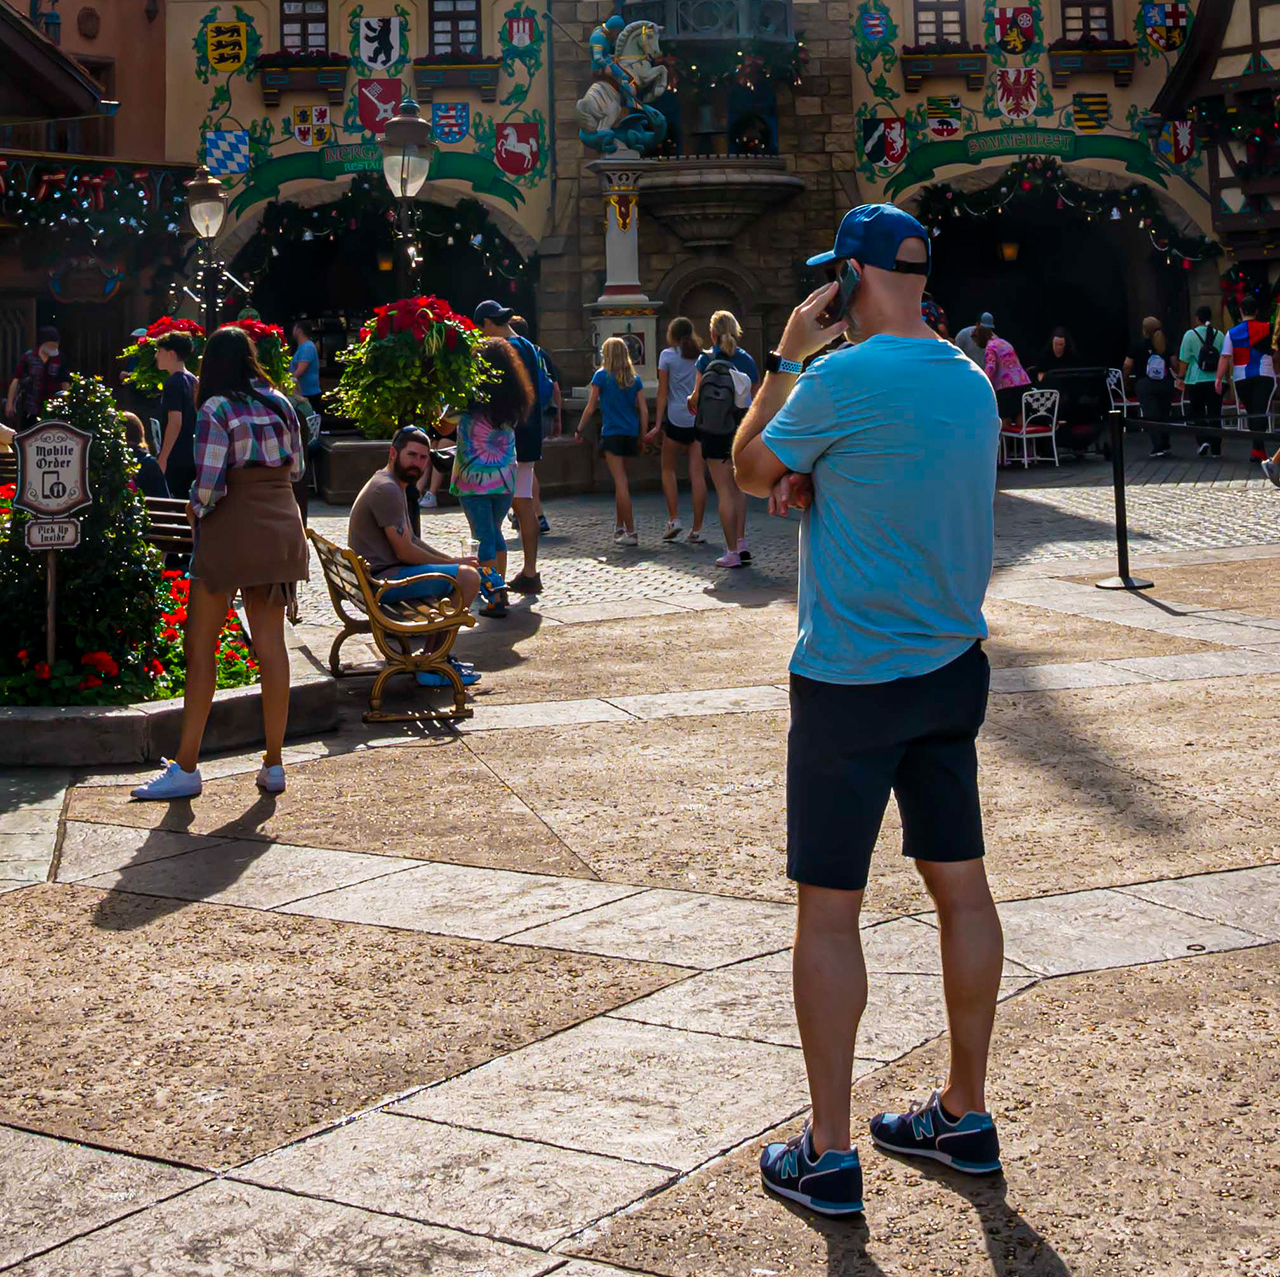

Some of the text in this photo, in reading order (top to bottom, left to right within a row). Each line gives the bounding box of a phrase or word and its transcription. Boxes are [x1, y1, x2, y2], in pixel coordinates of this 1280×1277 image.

[36, 445, 74, 458] Mobile
[36, 457, 71, 469] Order
[38, 525, 69, 535] Pick Up
[40, 533, 66, 543] Inside
